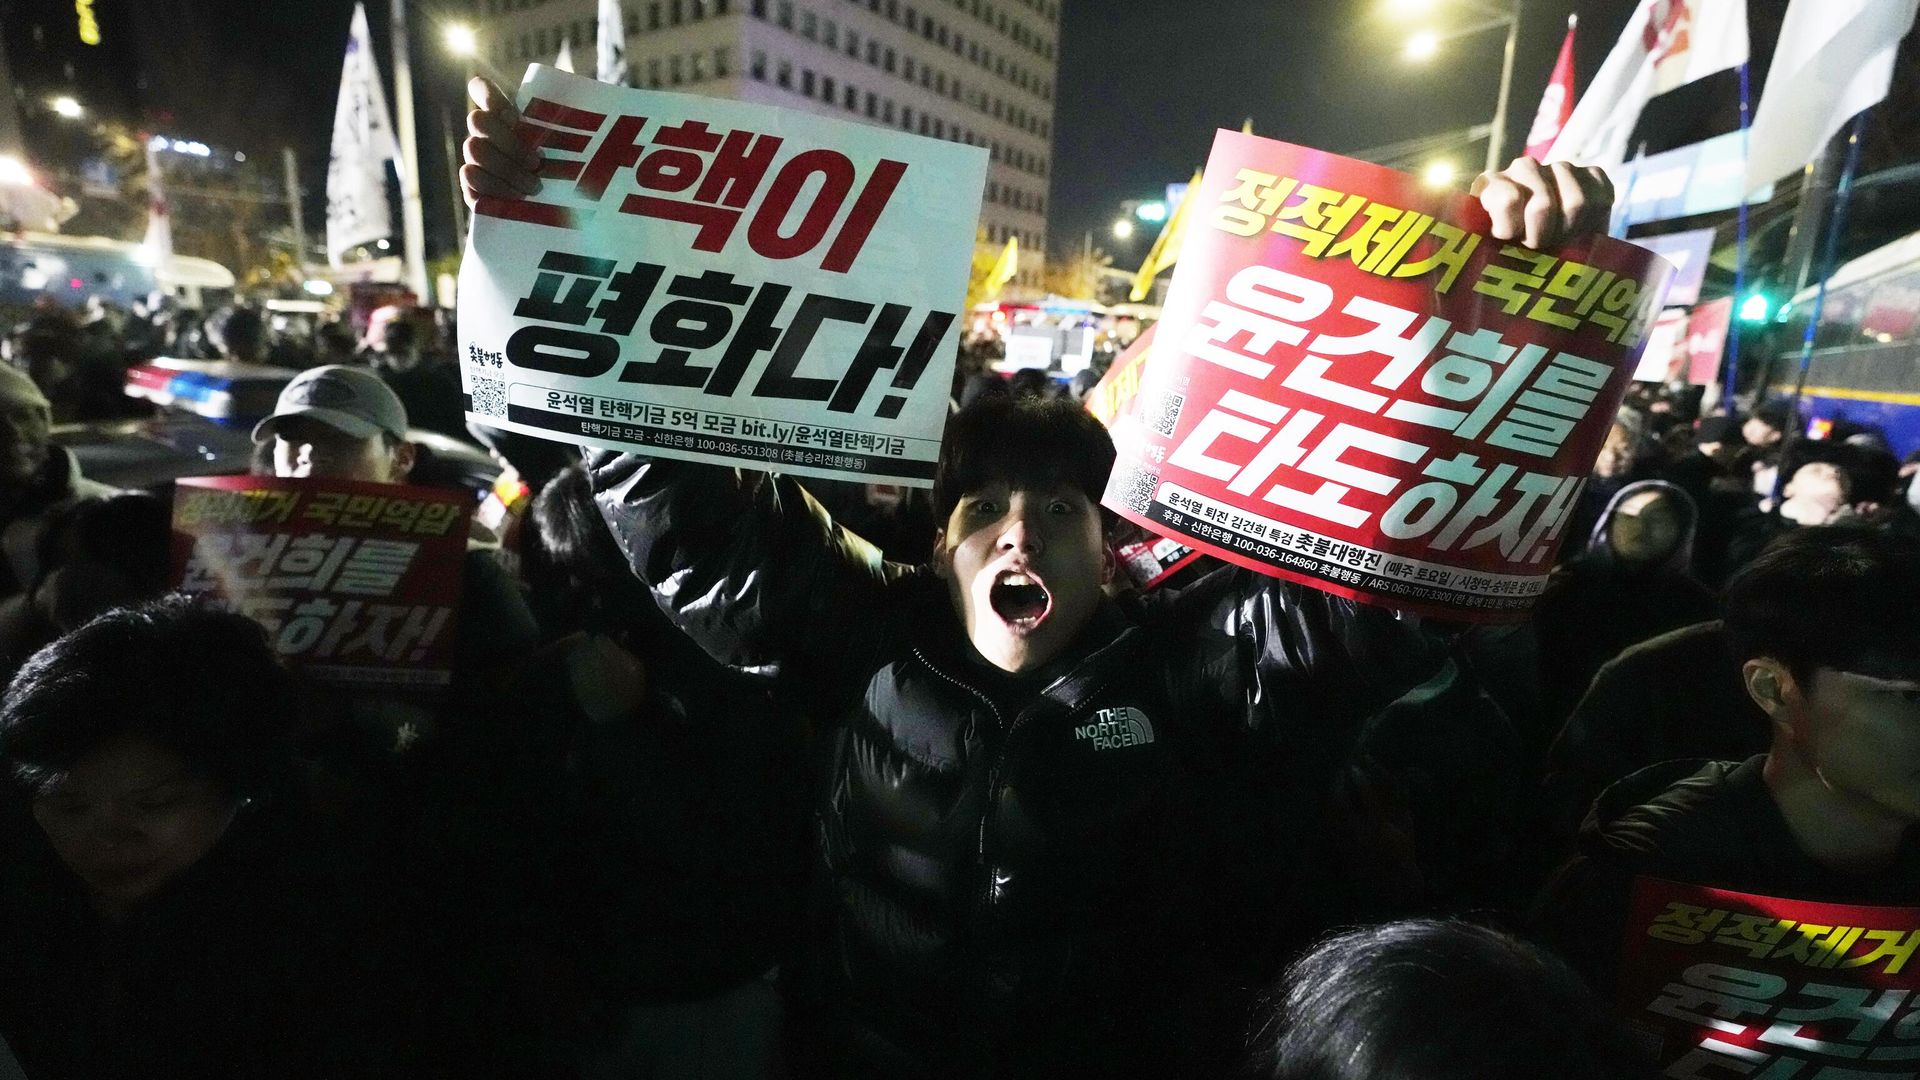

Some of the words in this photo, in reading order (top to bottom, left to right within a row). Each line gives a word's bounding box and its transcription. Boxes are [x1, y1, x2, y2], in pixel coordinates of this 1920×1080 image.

[475, 97, 909, 274] 탄핵이
[1208, 167, 1482, 295] 정적제거
[505, 250, 955, 419] 평화다!
[1182, 265, 1614, 458] 윤건희를
[546, 391, 594, 416] 윤석열
[600, 399, 666, 425] 탄핵기금
[670, 411, 698, 431] 5억
[703, 414, 737, 435] 모금
[741, 419, 906, 456] bit.ly/윤석열탄핵기금
[580, 421, 621, 438] 탄핵기금
[624, 427, 644, 441] 모금
[653, 432, 694, 448] 신한은행
[697, 438, 778, 459] 100-036-551308
[780, 447, 866, 471] (촛불승리전환행동)
[303, 491, 461, 536] 국민억압
[1166, 389, 1588, 564] 타도하자!
[1162, 509, 1184, 527] 후원
[1191, 521, 1233, 544] 신한은행
[1233, 537, 1318, 571] 100-036-164860
[1318, 563, 1362, 585] 촛불행동
[1368, 577, 1390, 591] ARS
[1391, 582, 1452, 602] 060-707-3300
[1168, 491, 1203, 515] 윤석열
[1204, 506, 1230, 524] 퇴진
[1231, 515, 1267, 537] 김건희
[1268, 528, 1295, 546] 특검
[1295, 532, 1382, 571] 촛불대행진
[1383, 559, 1414, 578] (매주
[1414, 568, 1451, 585] 토요일
[1075, 720, 1130, 740] NORTH
[1093, 733, 1132, 751] FACE
[1096, 706, 1128, 723] THE
[1647, 902, 1920, 975] 정적제거
[1646, 962, 1920, 1061] 윤건
